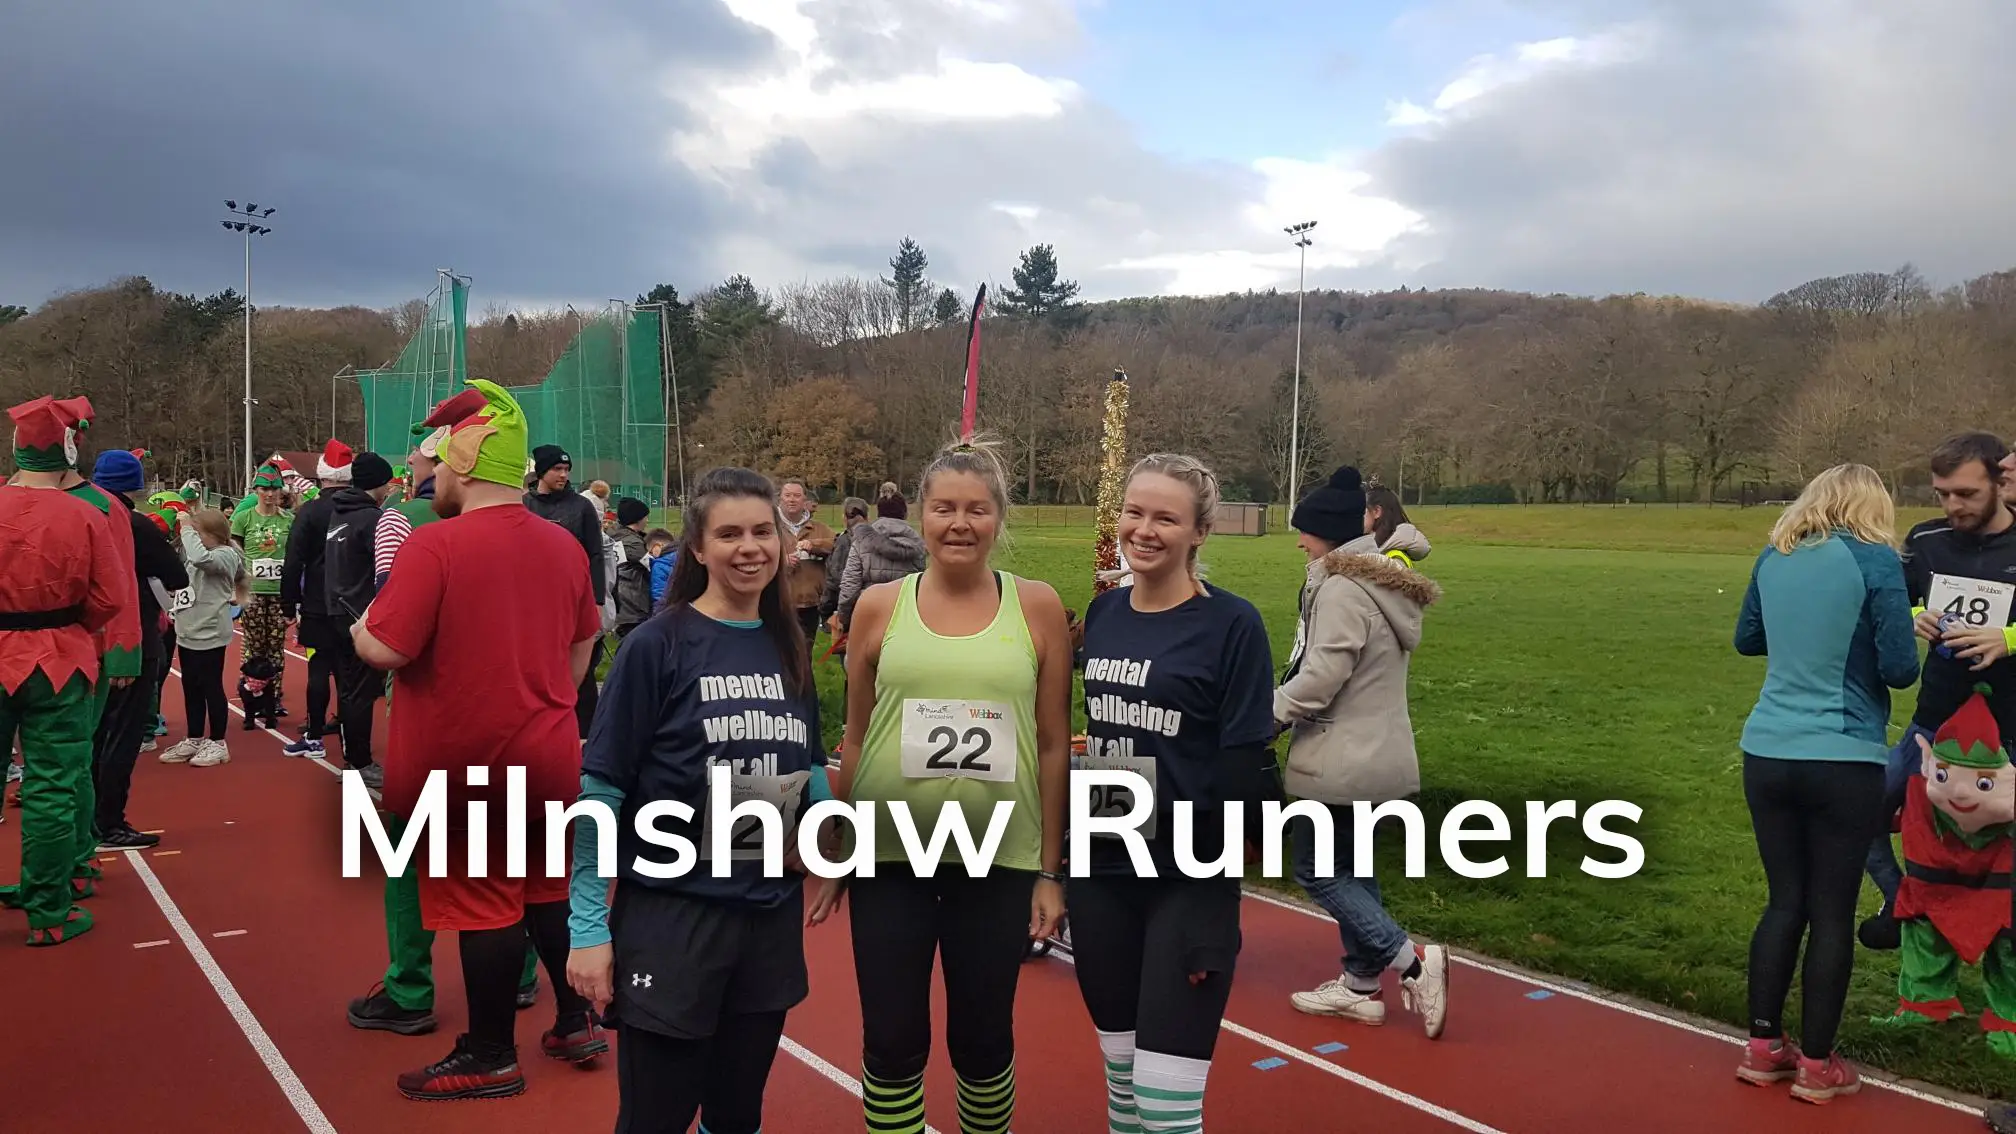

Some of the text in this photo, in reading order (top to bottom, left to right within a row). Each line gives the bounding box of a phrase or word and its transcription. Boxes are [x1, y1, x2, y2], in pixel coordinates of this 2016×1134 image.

[255, 565, 283, 578] 213
[1943, 595, 1990, 626] 48
[1085, 657, 1152, 687] mental
[700, 673, 785, 702] mental
[969, 708, 1003, 720] Webbox
[926, 726, 992, 772] 22
